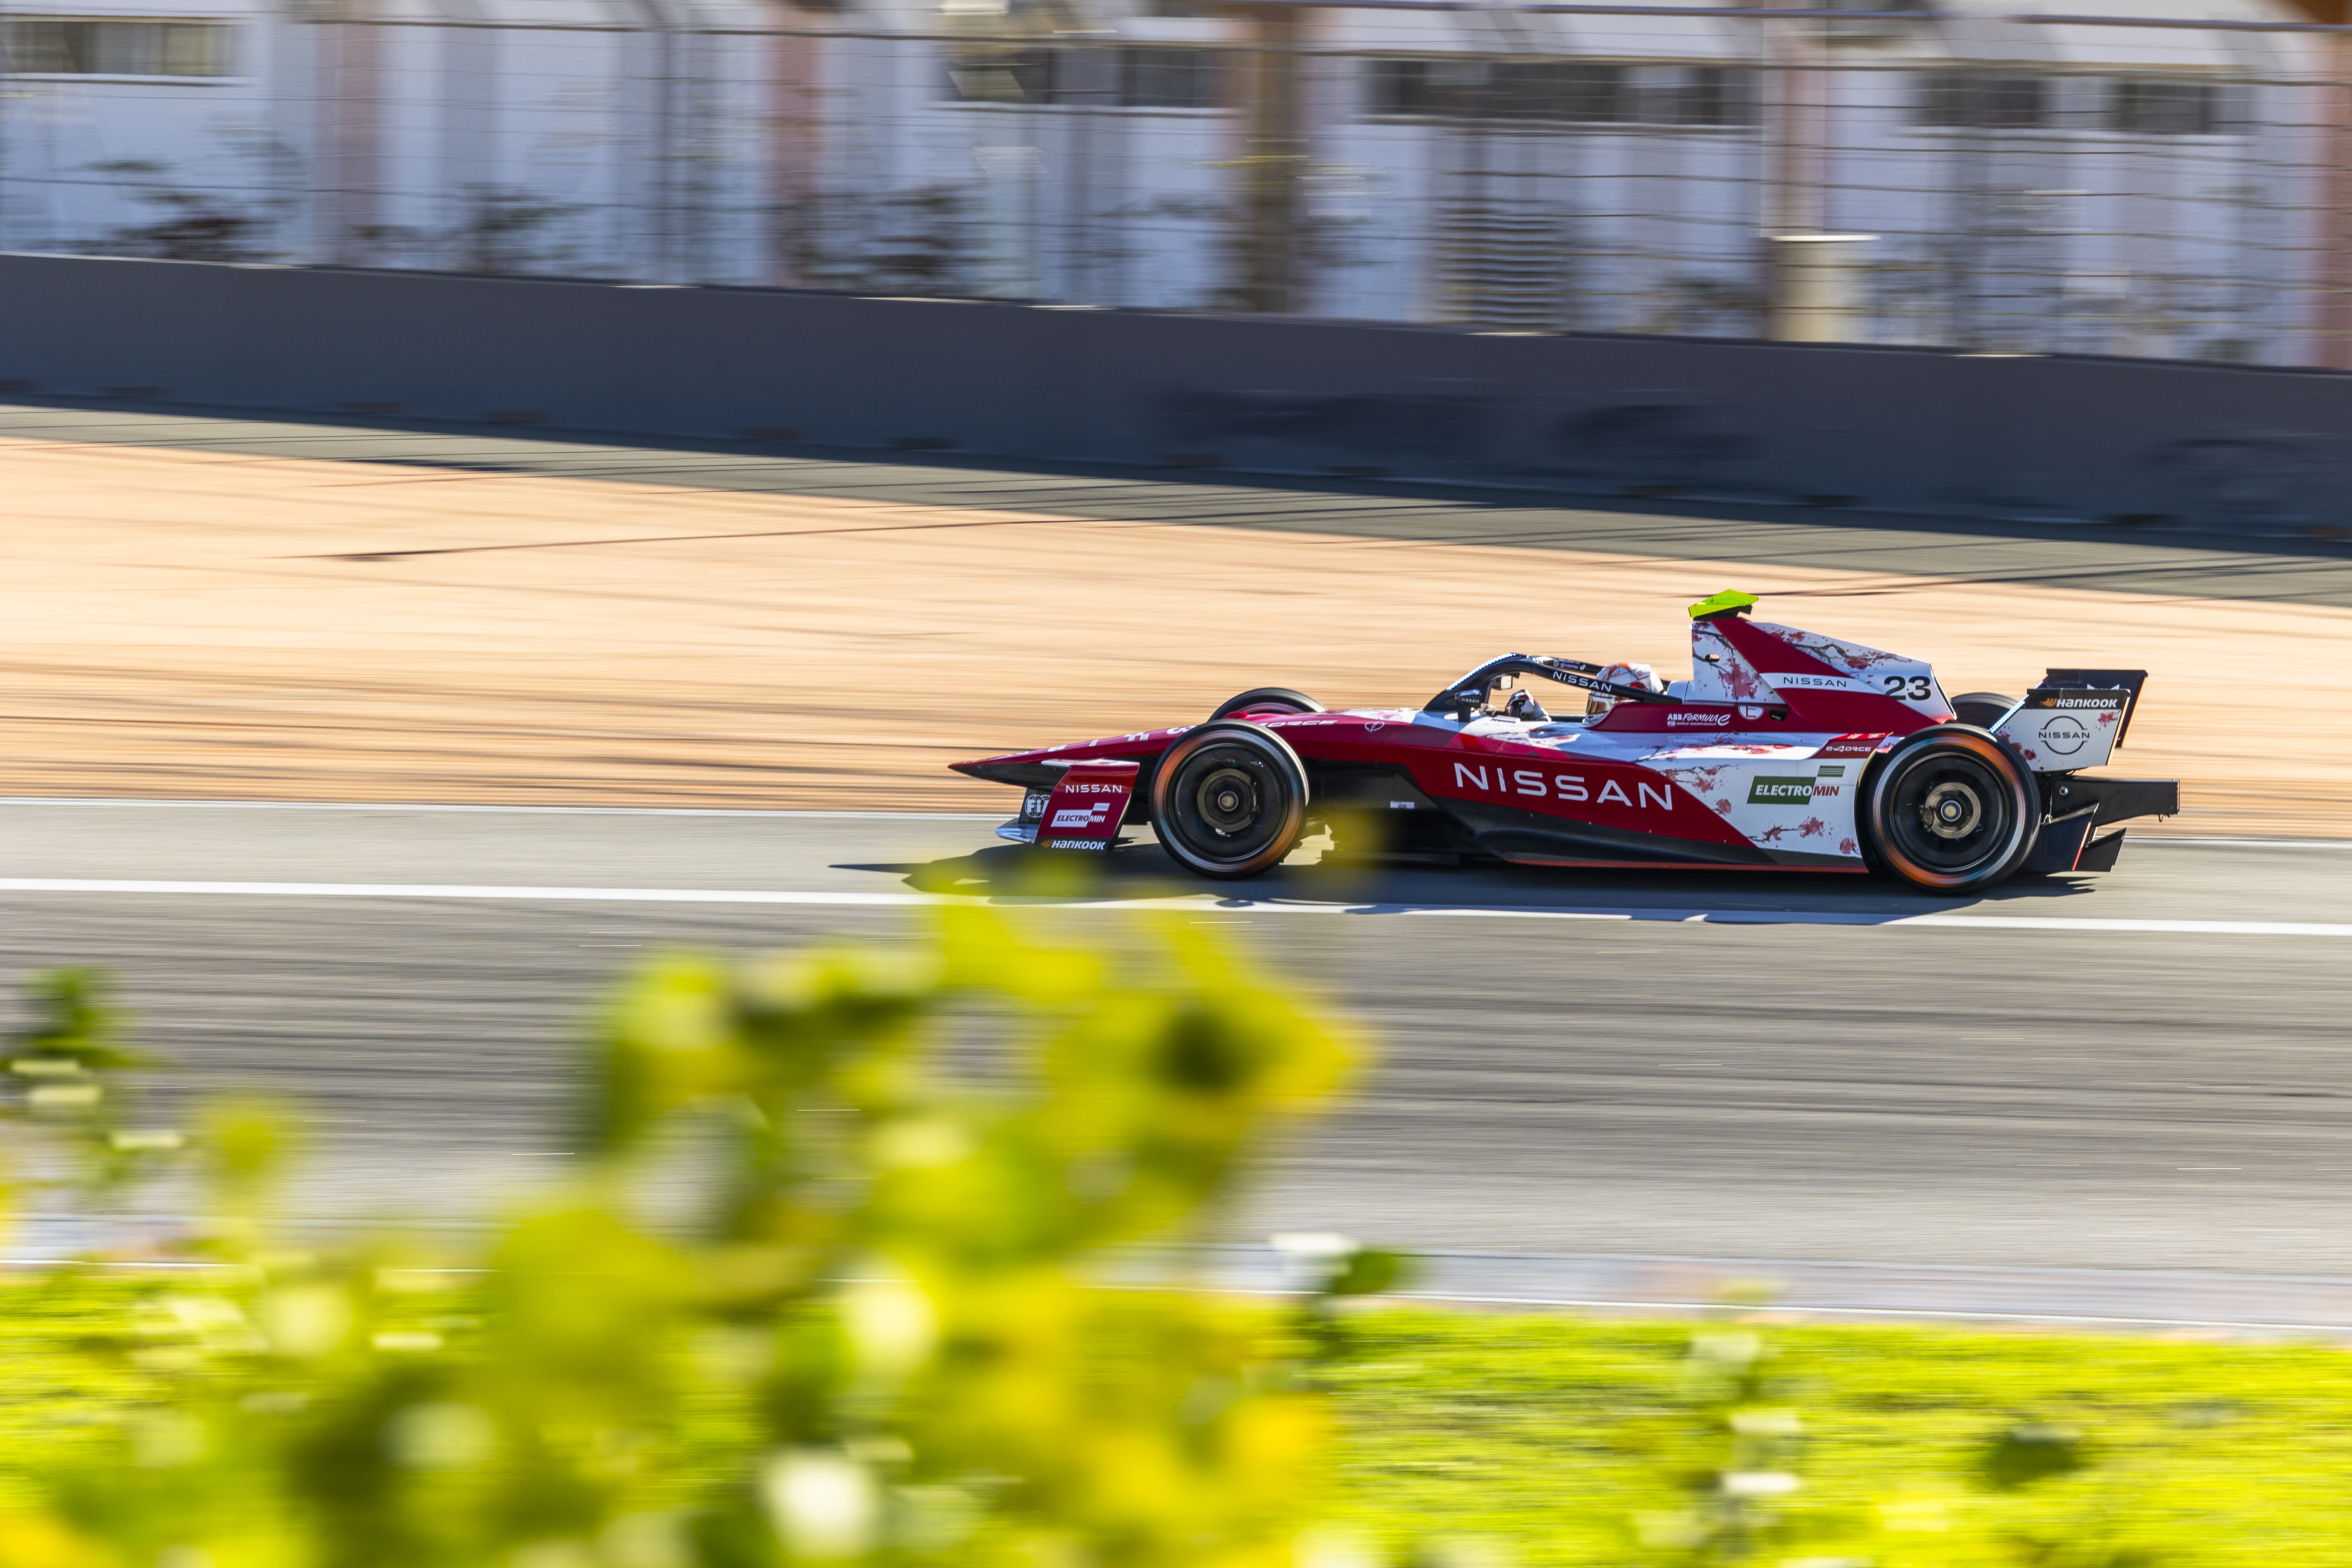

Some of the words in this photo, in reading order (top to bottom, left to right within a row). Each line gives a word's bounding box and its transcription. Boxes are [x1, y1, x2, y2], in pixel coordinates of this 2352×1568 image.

[1553, 671, 1612, 692] NISSAN
[1783, 677, 1847, 687] NISSAN
[1883, 676, 1931, 701] 23
[1682, 713, 1719, 722] FORMULA
[1066, 784, 1122, 793] NISSAN
[1454, 763, 1672, 810] NISSAN
[1755, 784, 1840, 796] ELECTROMIN
